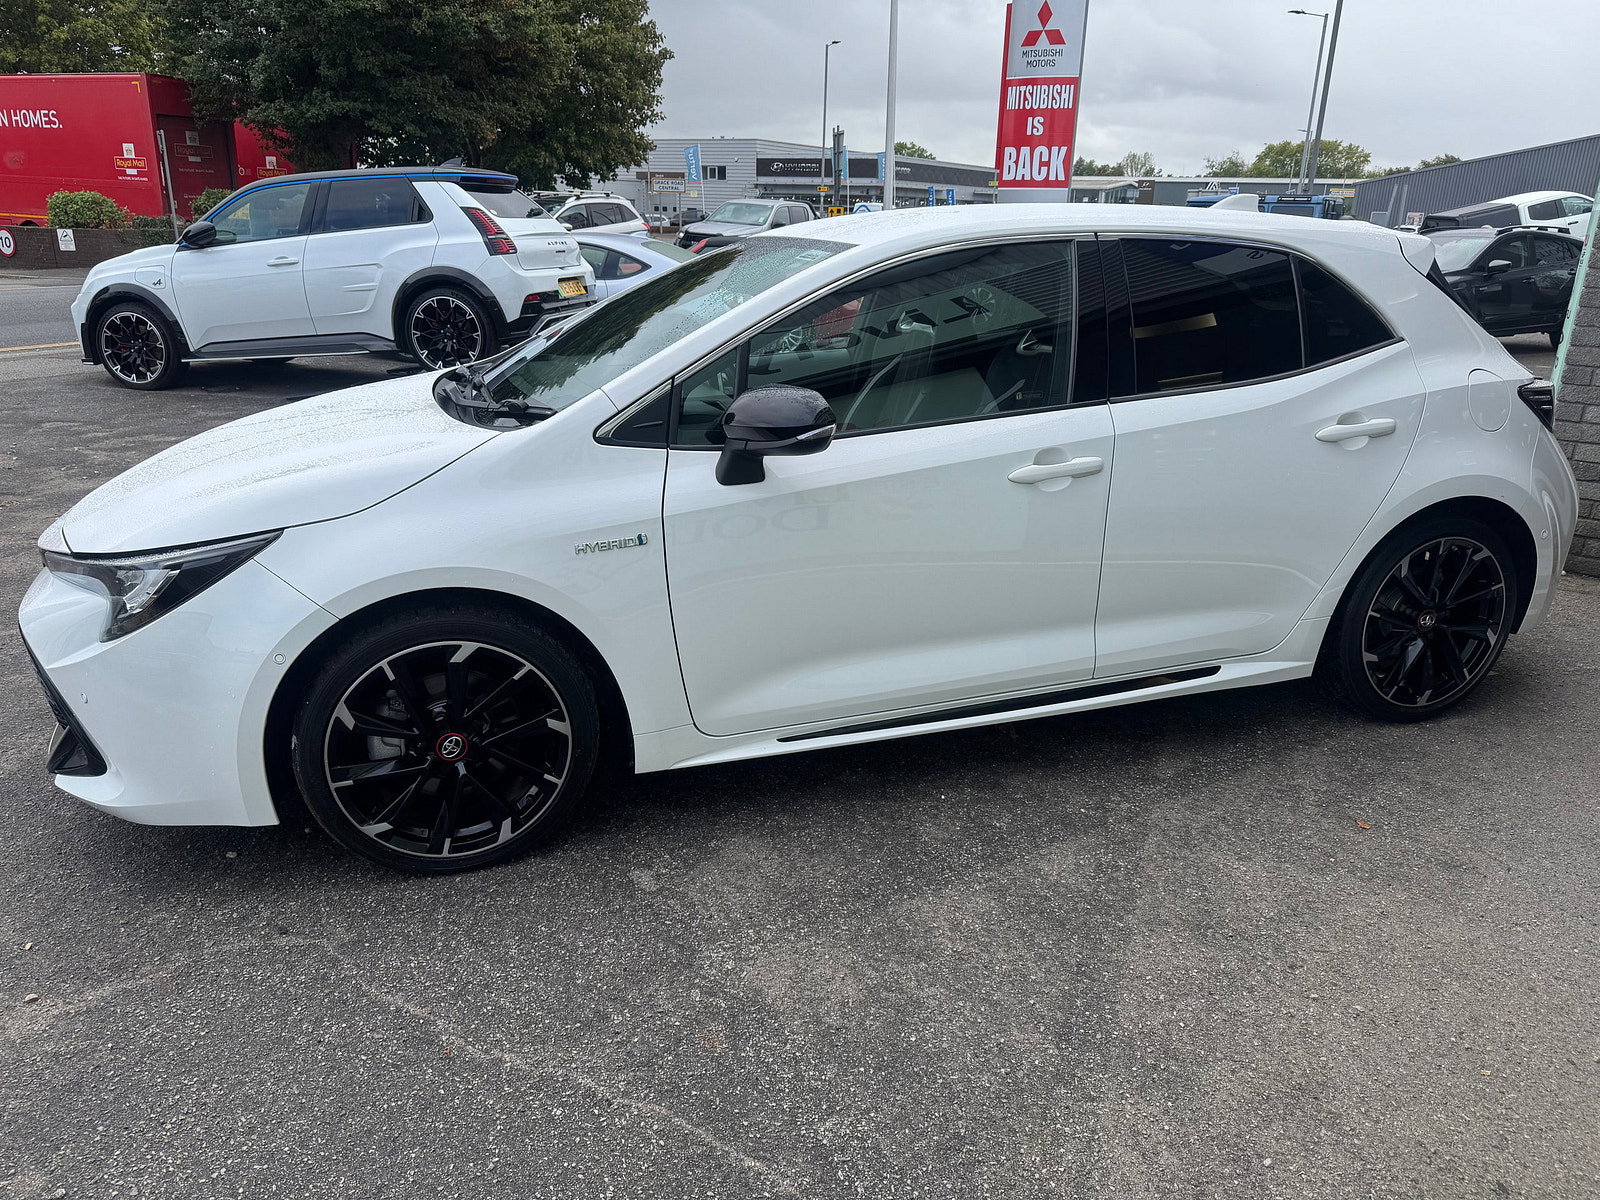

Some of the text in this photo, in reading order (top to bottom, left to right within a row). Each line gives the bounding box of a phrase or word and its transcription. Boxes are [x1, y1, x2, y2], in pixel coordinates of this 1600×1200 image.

[1021, 48, 1064, 59] MITSUBISHI
[1025, 58, 1056, 69] MOTORS
[1006, 84, 1075, 111] MITSUBISHI
[10, 109, 64, 129] HOMES.
[1026, 116, 1045, 136] IS
[116, 158, 145, 168] Royal Mail
[1002, 145, 1068, 182] BACK
[0, 236, 12, 249] 10
[574, 536, 637, 555] HYBRID
